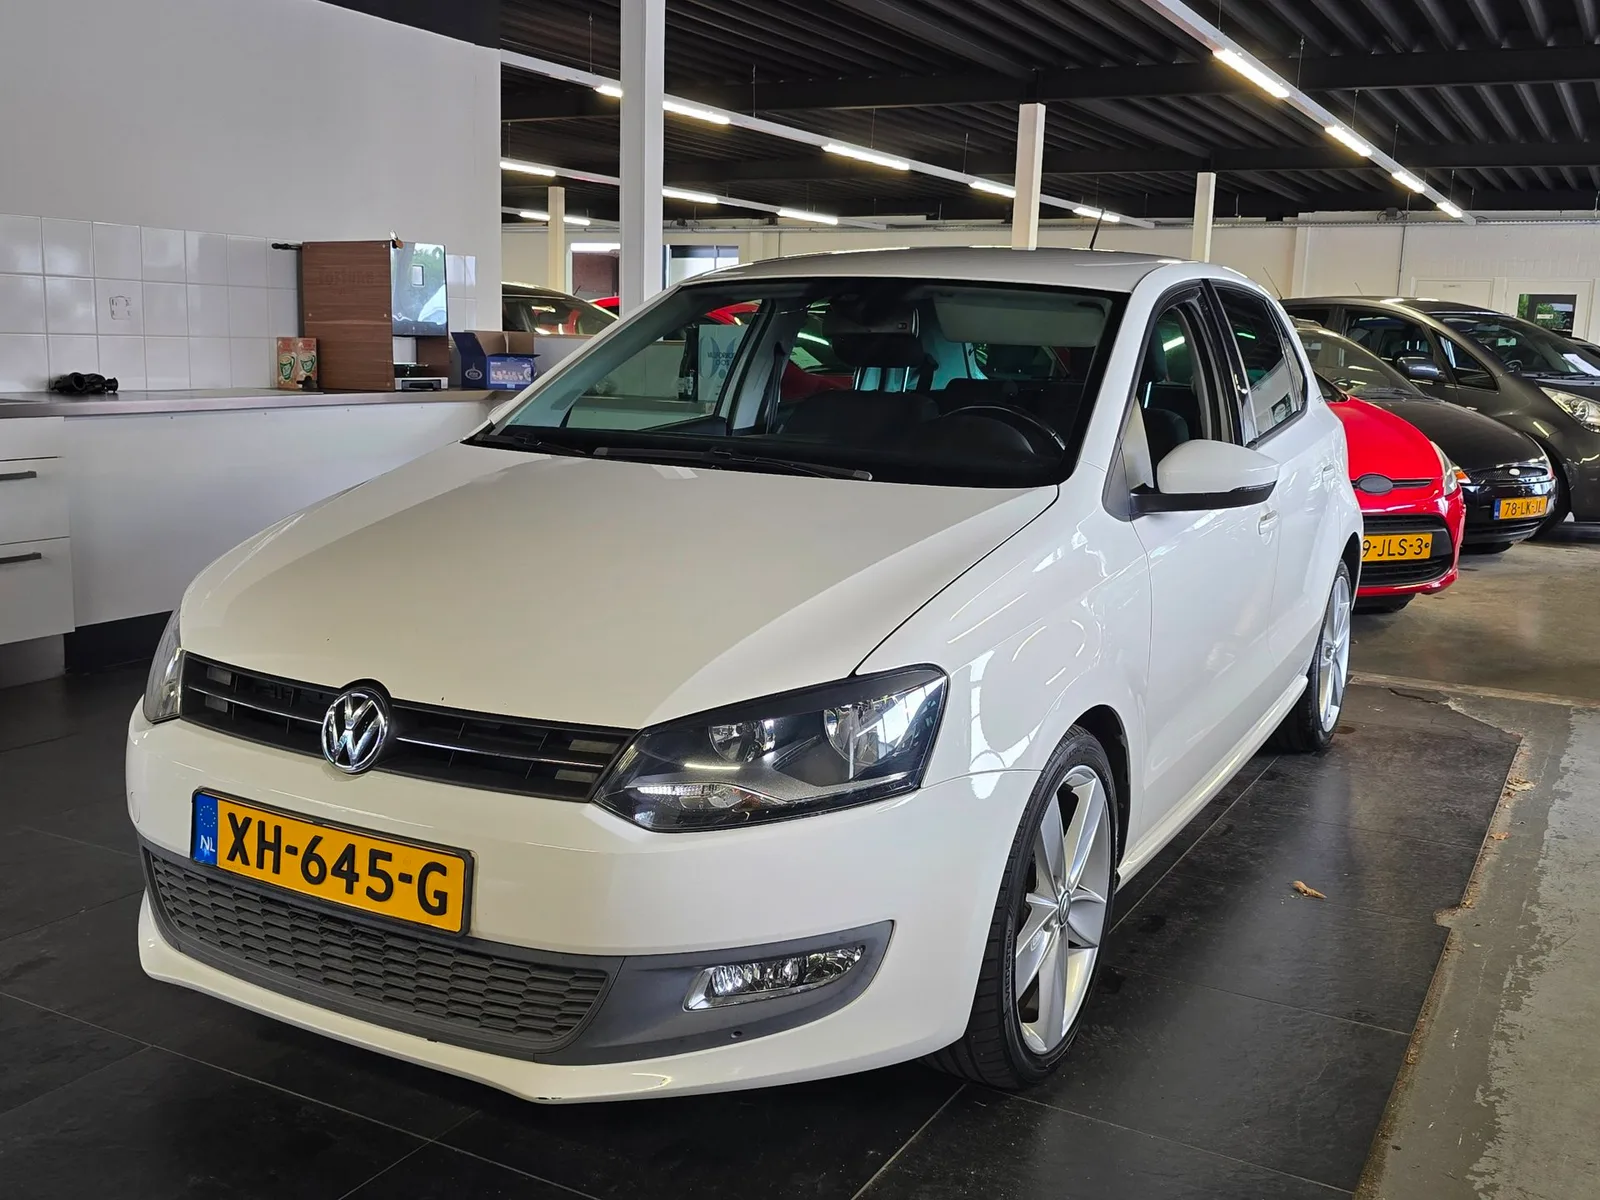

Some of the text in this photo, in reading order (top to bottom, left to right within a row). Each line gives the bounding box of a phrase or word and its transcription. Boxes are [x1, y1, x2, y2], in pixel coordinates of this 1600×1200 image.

[1505, 501, 1542, 516] 78-LK-JL
[1362, 538, 1424, 557] 9-JLS-3
[200, 835, 215, 852] NL
[226, 812, 448, 916] XH-645-G
